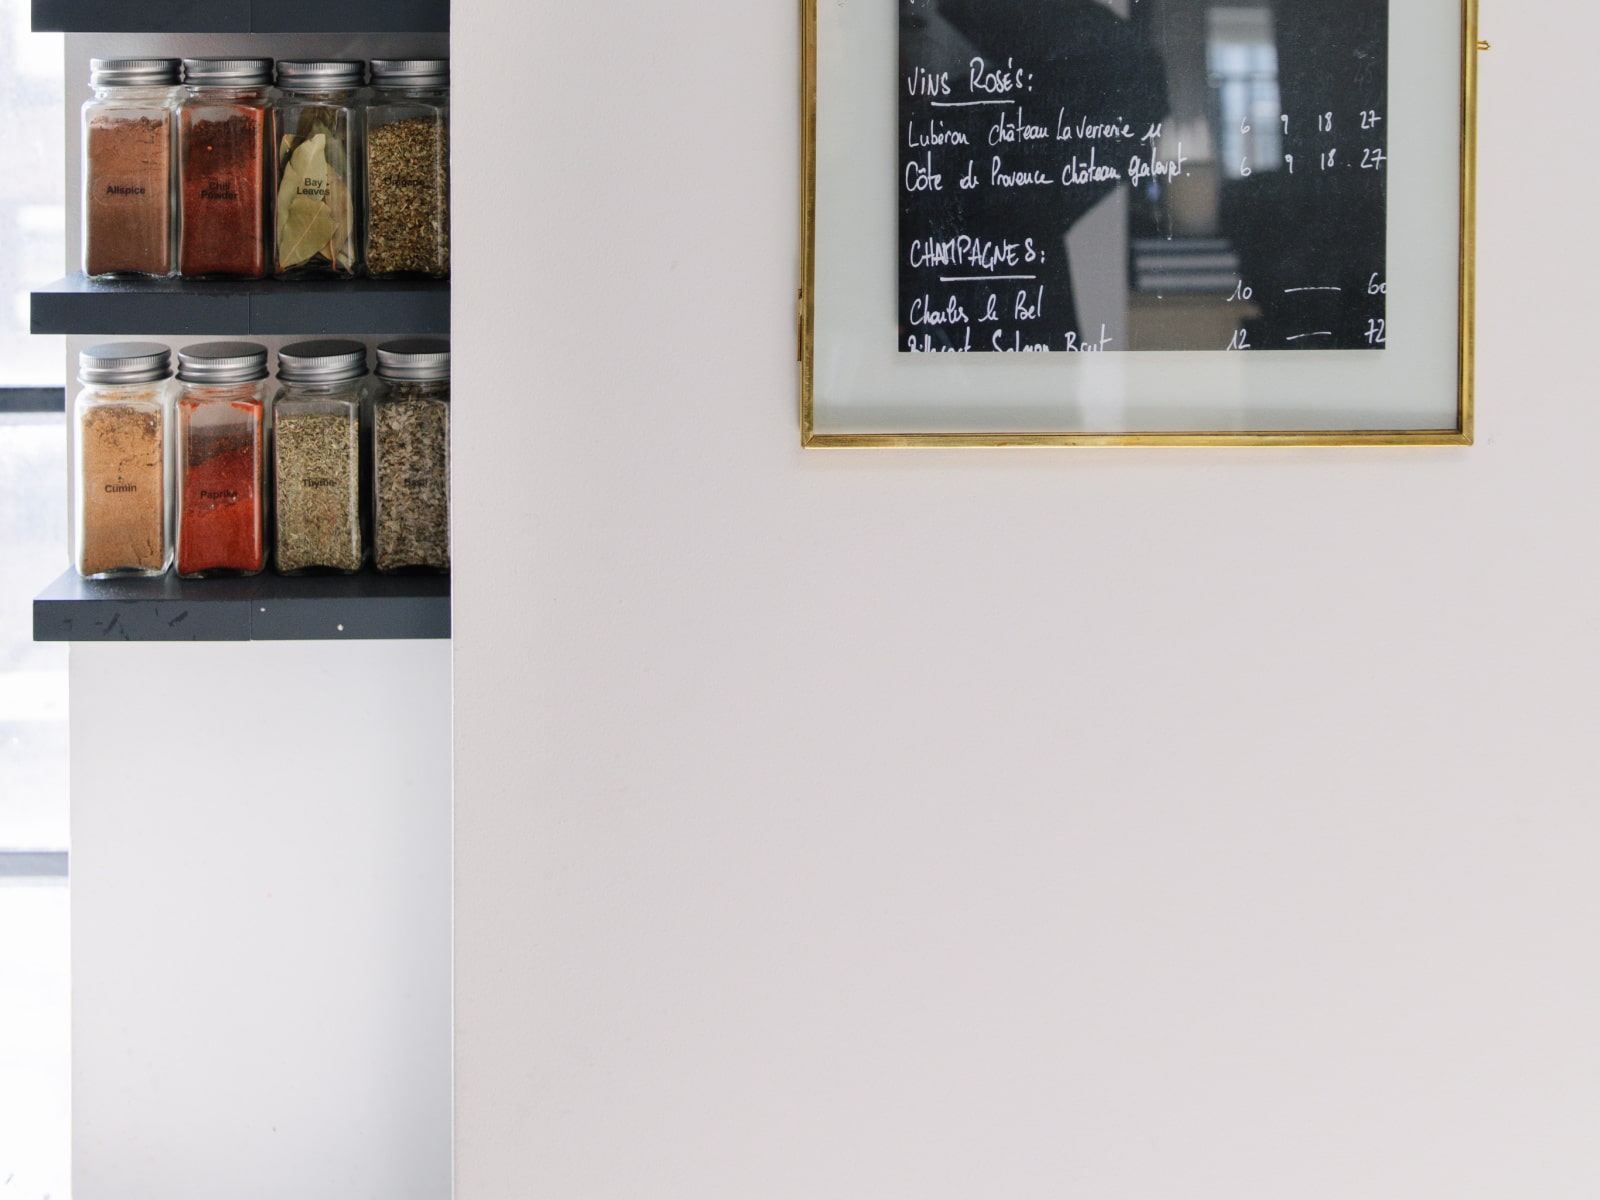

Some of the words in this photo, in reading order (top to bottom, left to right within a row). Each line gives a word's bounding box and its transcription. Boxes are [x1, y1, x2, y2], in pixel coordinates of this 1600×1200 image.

[1240, 116, 1250, 134] 6
[1281, 114, 1288, 134] 9
[1319, 112, 1333, 131] 18
[1360, 110, 1382, 129] 27
[905, 151, 943, 191] Côte
[960, 160, 979, 189] de
[1240, 157, 1251, 177] 6
[1285, 154, 1293, 174] 9
[1321, 148, 1336, 170] 18
[1360, 148, 1386, 170] 27
[106, 185, 146, 196] Allspice
[297, 187, 330, 196] Leaves
[304, 178, 323, 188] Bay
[201, 190, 238, 199] Powder
[910, 235, 1045, 271] CHAMPAGNES:
[1227, 280, 1252, 301] 10
[1015, 285, 1044, 319] Bel
[1227, 328, 1251, 350] 12
[1364, 319, 1386, 344] 72
[104, 484, 137, 493] Cumin
[200, 490, 237, 499] Paprika
